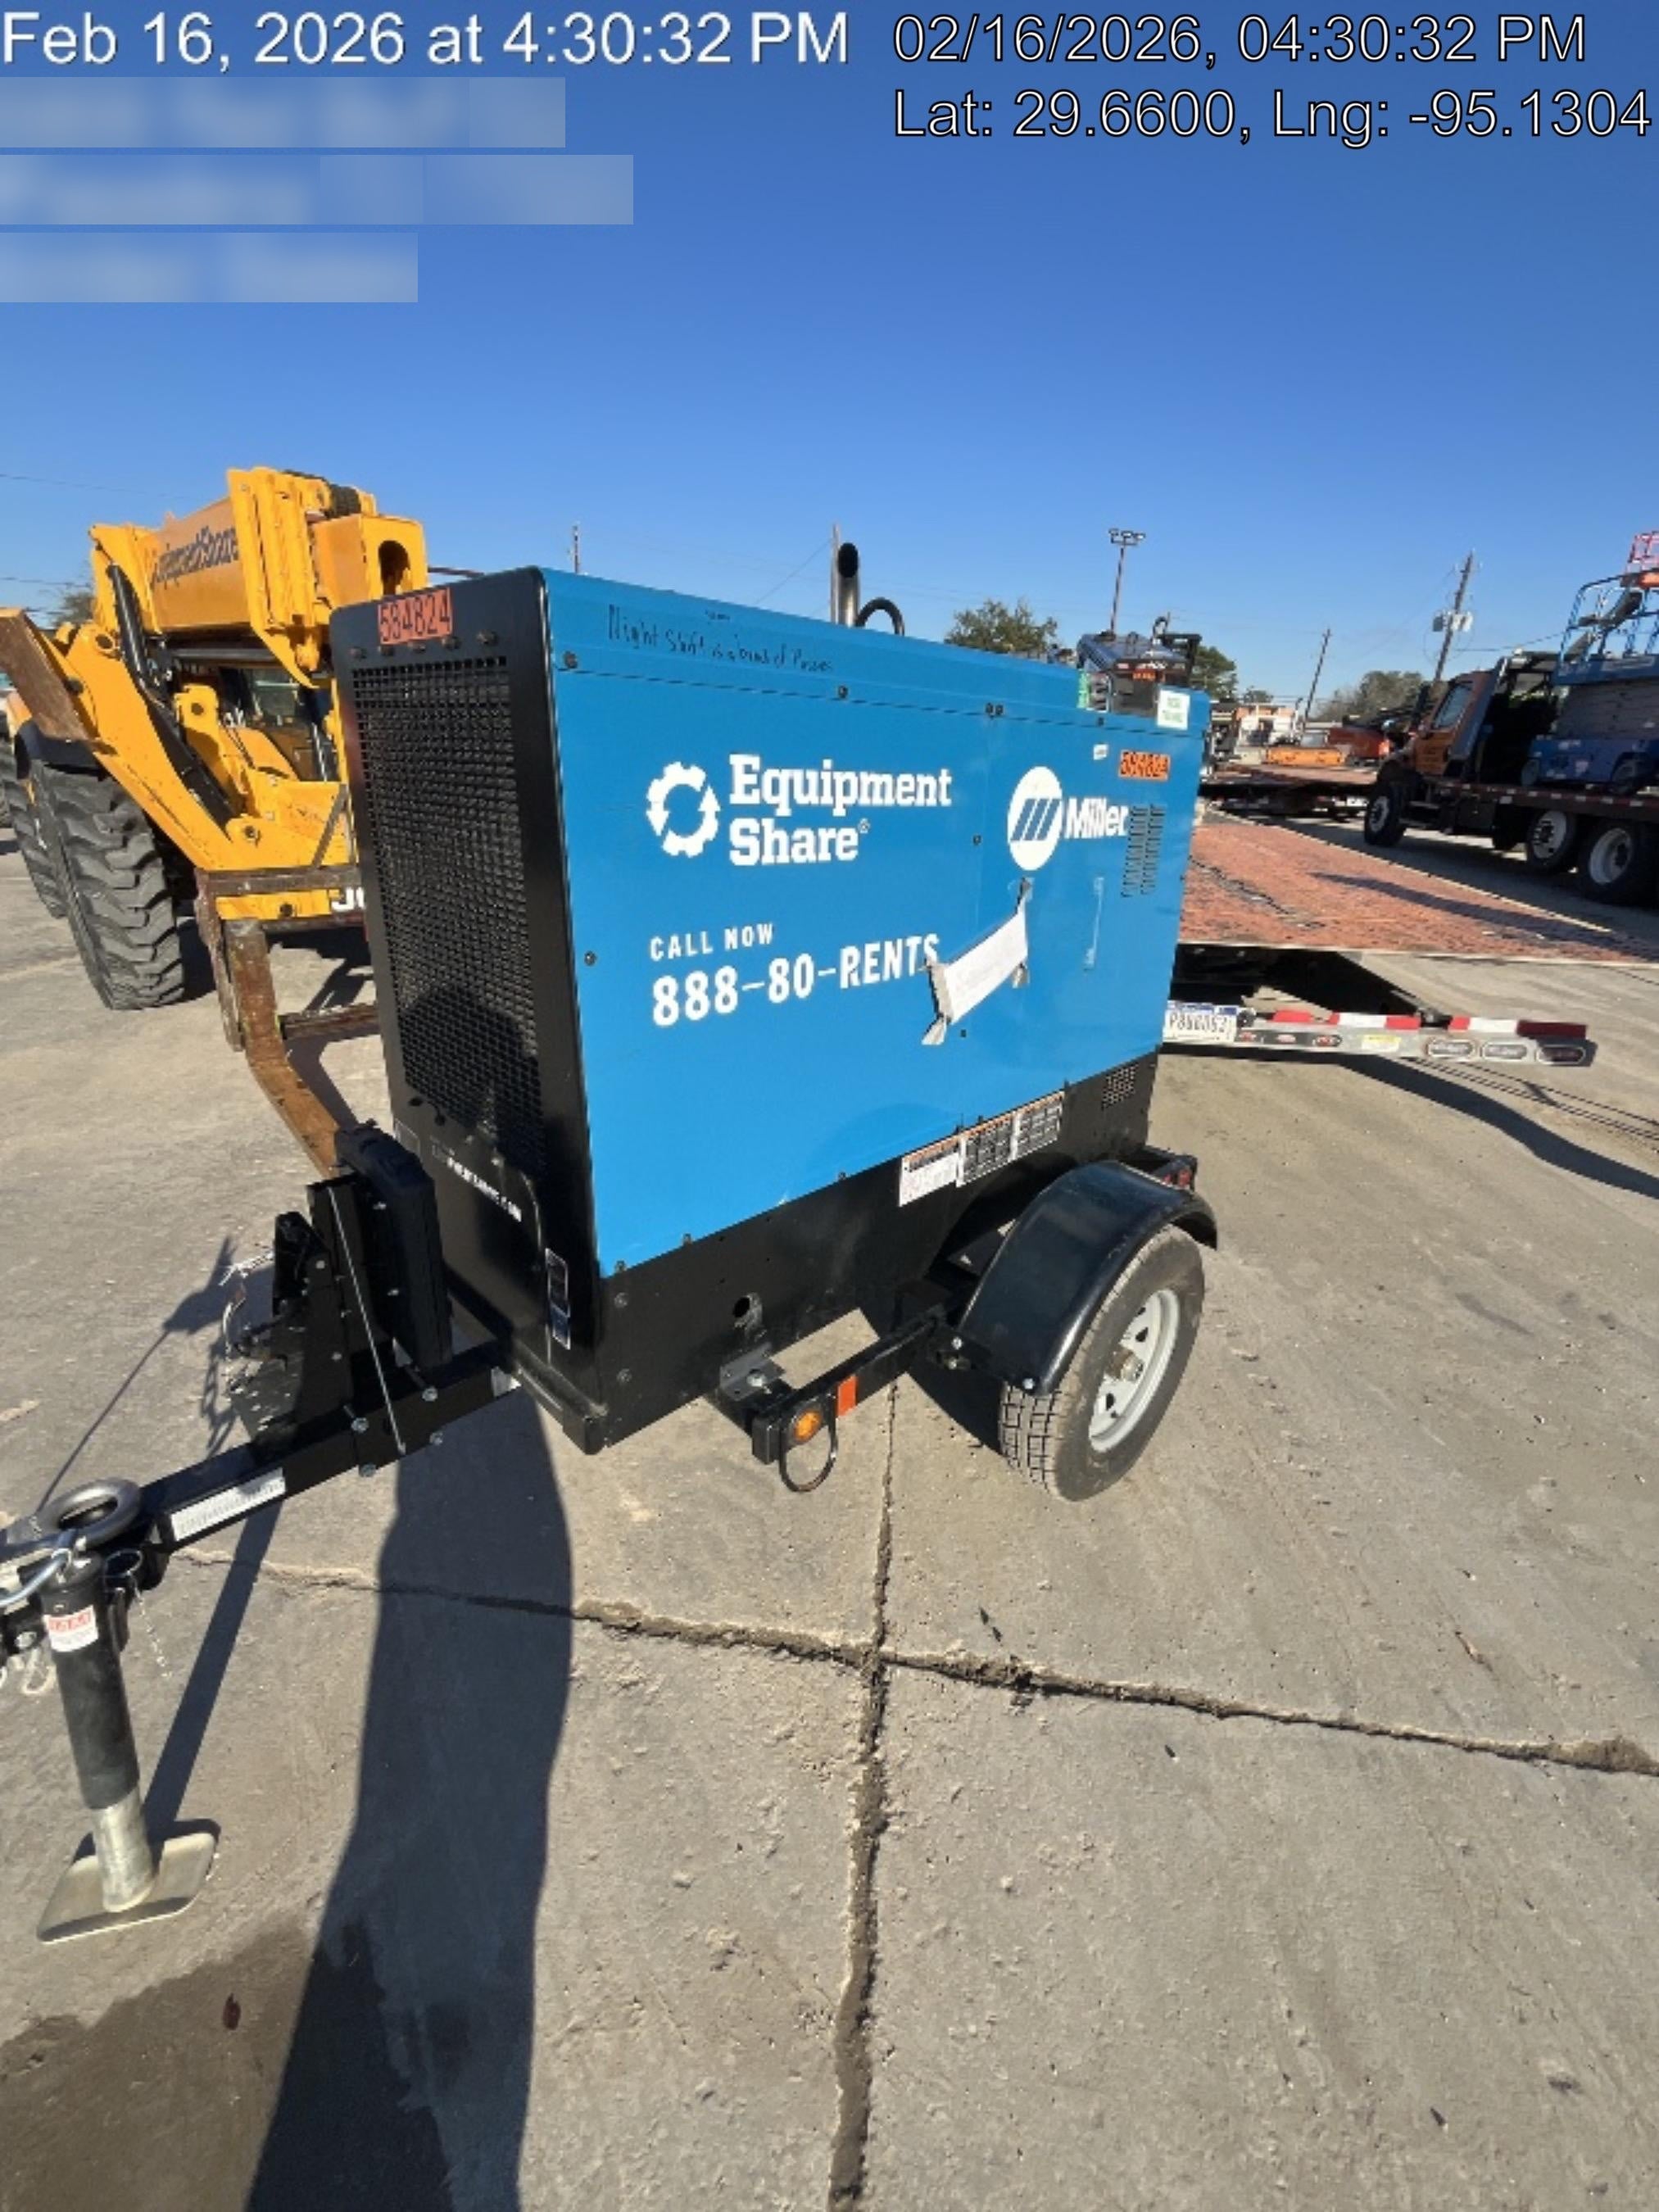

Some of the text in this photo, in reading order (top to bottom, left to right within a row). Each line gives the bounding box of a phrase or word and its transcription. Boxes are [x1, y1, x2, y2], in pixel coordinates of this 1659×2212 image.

[728, 752, 953, 817] Equipment
[1063, 796, 1129, 840] Miller
[650, 922, 775, 962] CALL NOW
